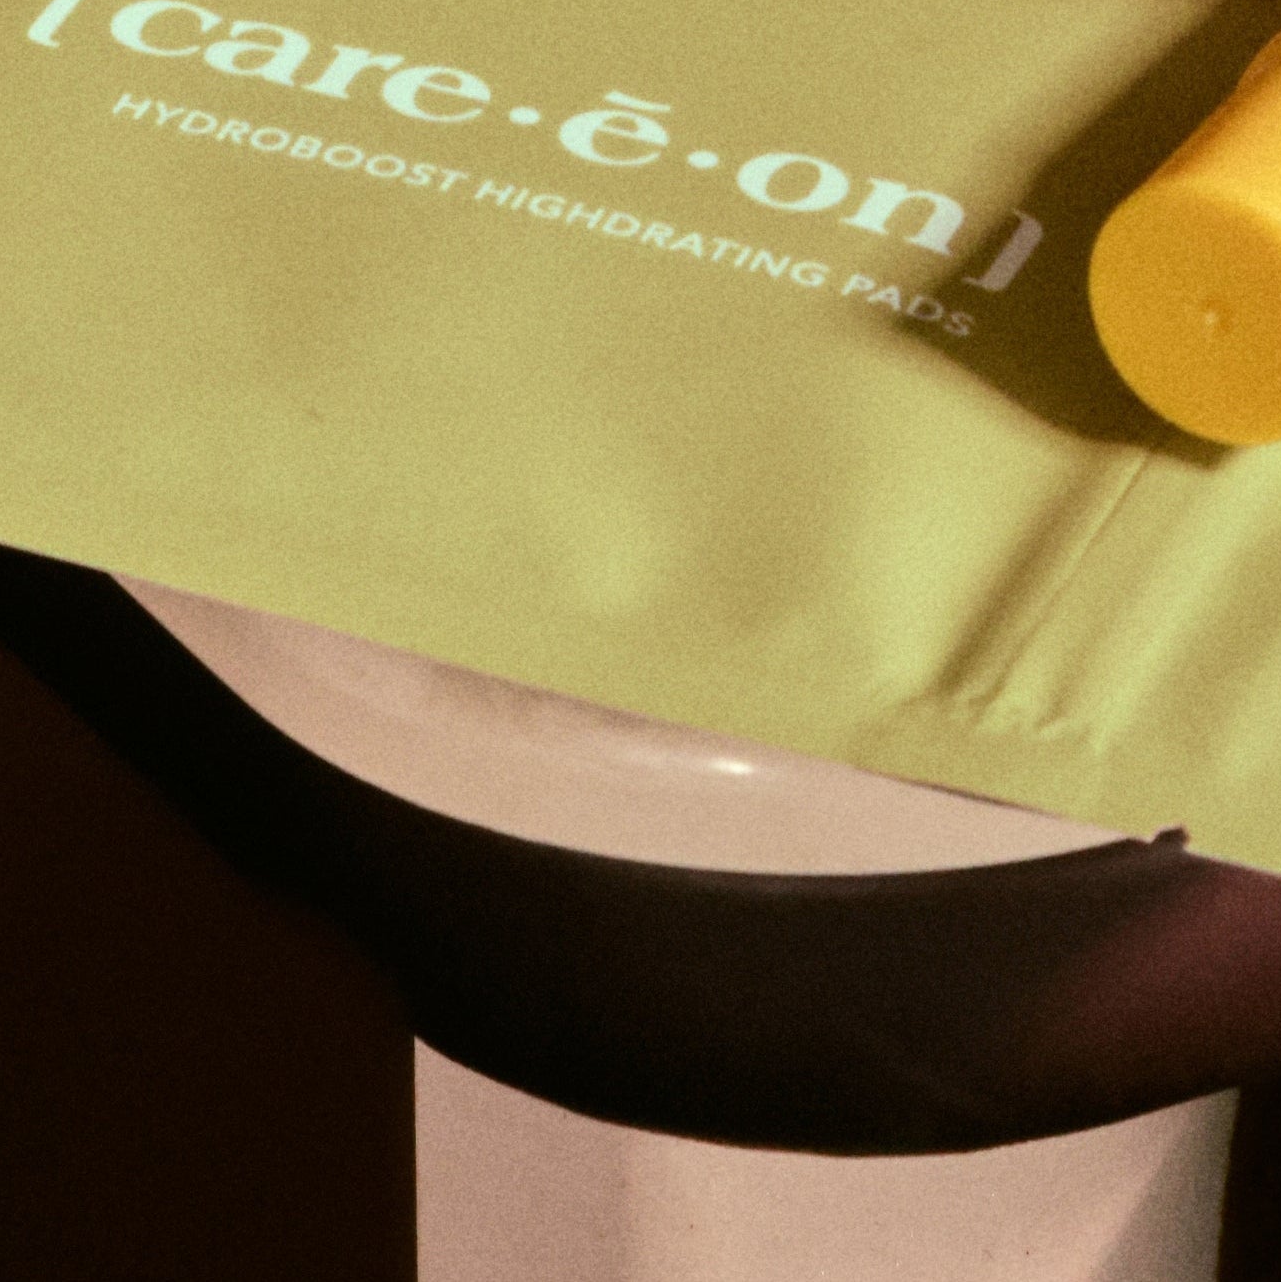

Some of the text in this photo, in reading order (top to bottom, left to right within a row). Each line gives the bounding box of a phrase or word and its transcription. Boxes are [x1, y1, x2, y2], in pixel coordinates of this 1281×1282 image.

[111, 92, 974, 338] HYDROBOOST HIGHDRATING PADS
